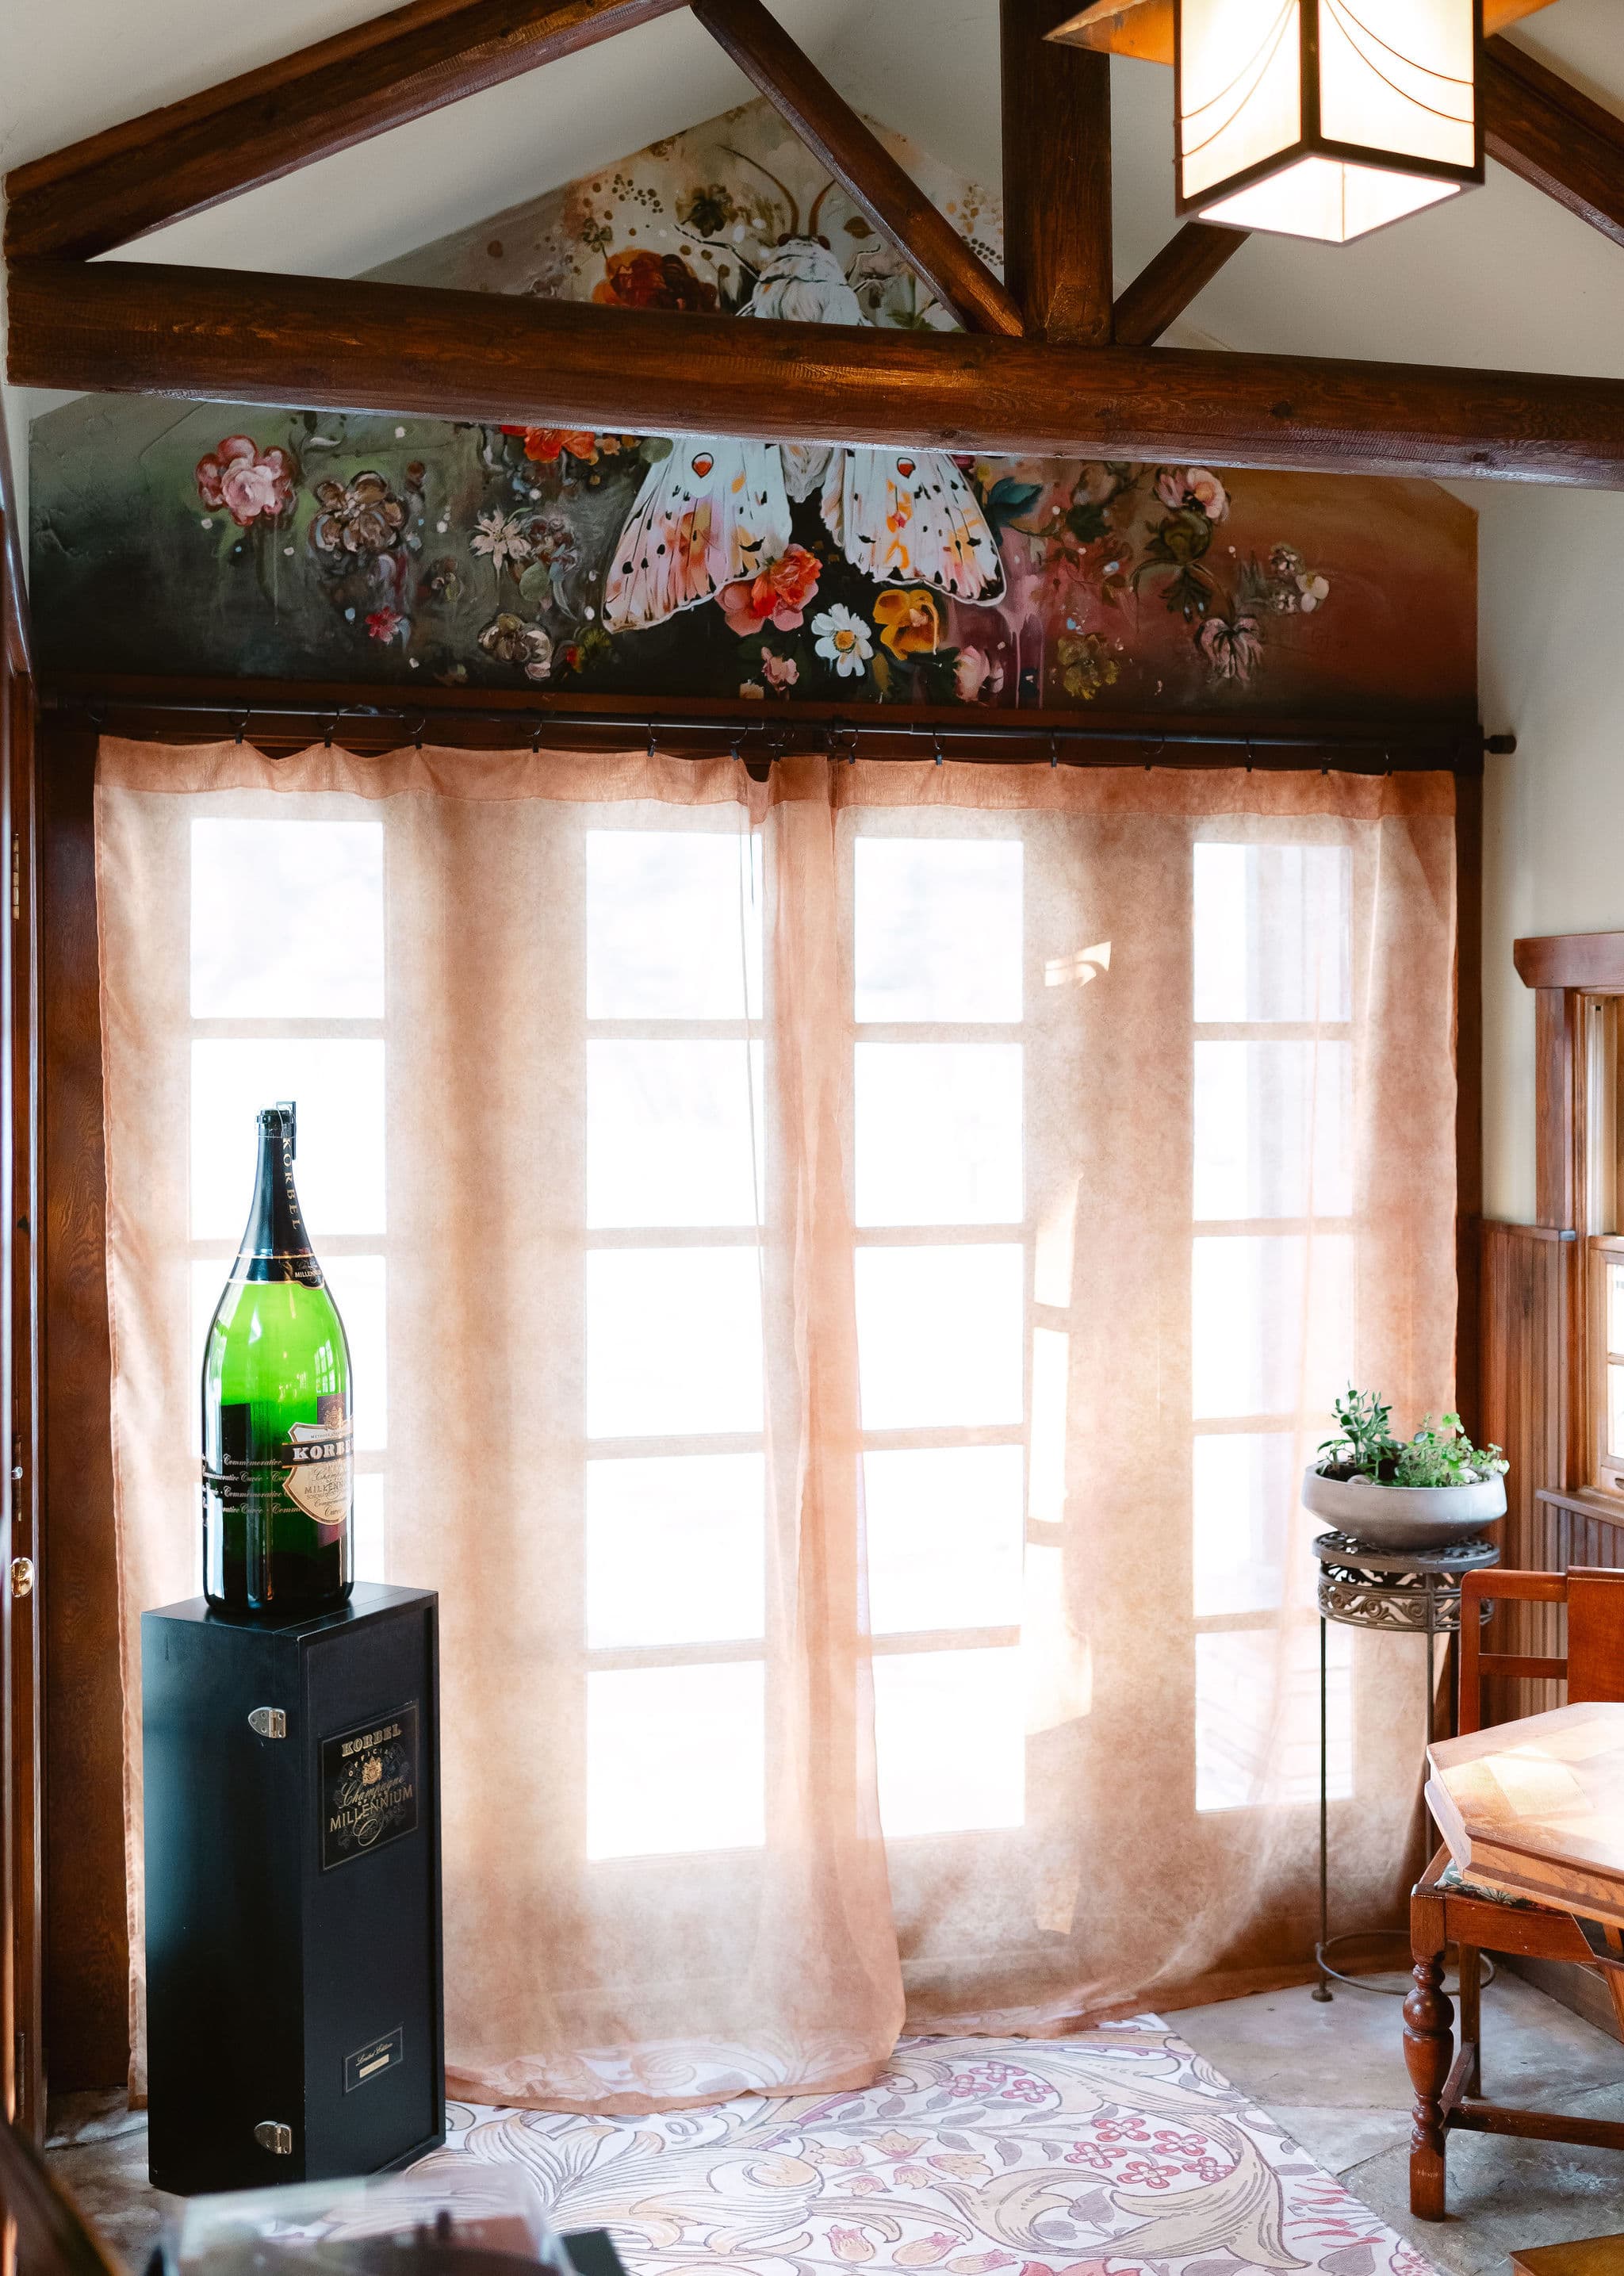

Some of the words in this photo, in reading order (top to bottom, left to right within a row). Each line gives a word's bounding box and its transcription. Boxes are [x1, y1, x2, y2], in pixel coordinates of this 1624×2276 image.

[282, 1137, 301, 1230] KORBEL
[223, 1453, 282, 1466] Commemorative
[223, 1485, 282, 1499] Commemorative
[342, 1723, 402, 1757] KORBEL
[329, 1784, 412, 1833] MILLENNIUM
[338, 1775, 405, 1809] Champagne
